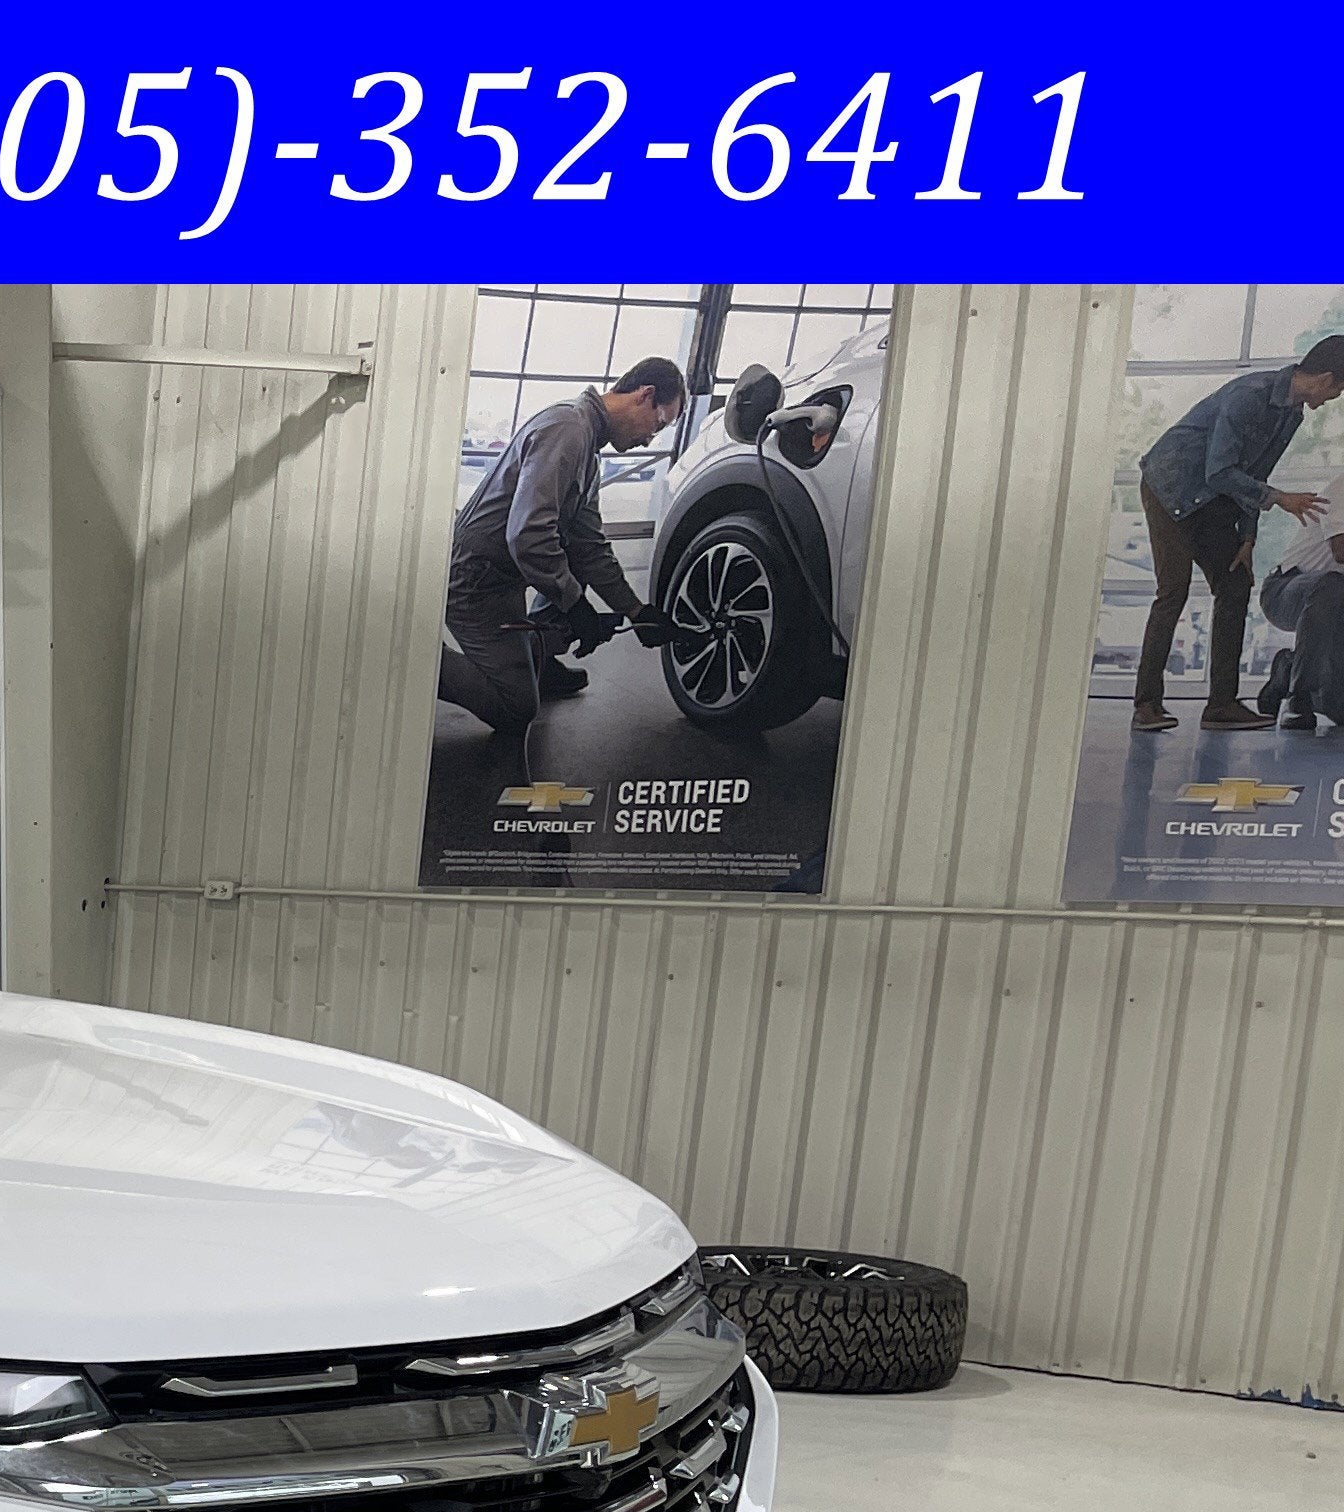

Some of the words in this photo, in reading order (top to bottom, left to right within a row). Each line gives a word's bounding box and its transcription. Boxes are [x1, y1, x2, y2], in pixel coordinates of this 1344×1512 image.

[618, 778, 751, 805] CERTIFIED
[493, 819, 597, 834] CHEVROLET
[614, 808, 724, 834] SERVICE
[1165, 821, 1304, 838] CHEVROLET
